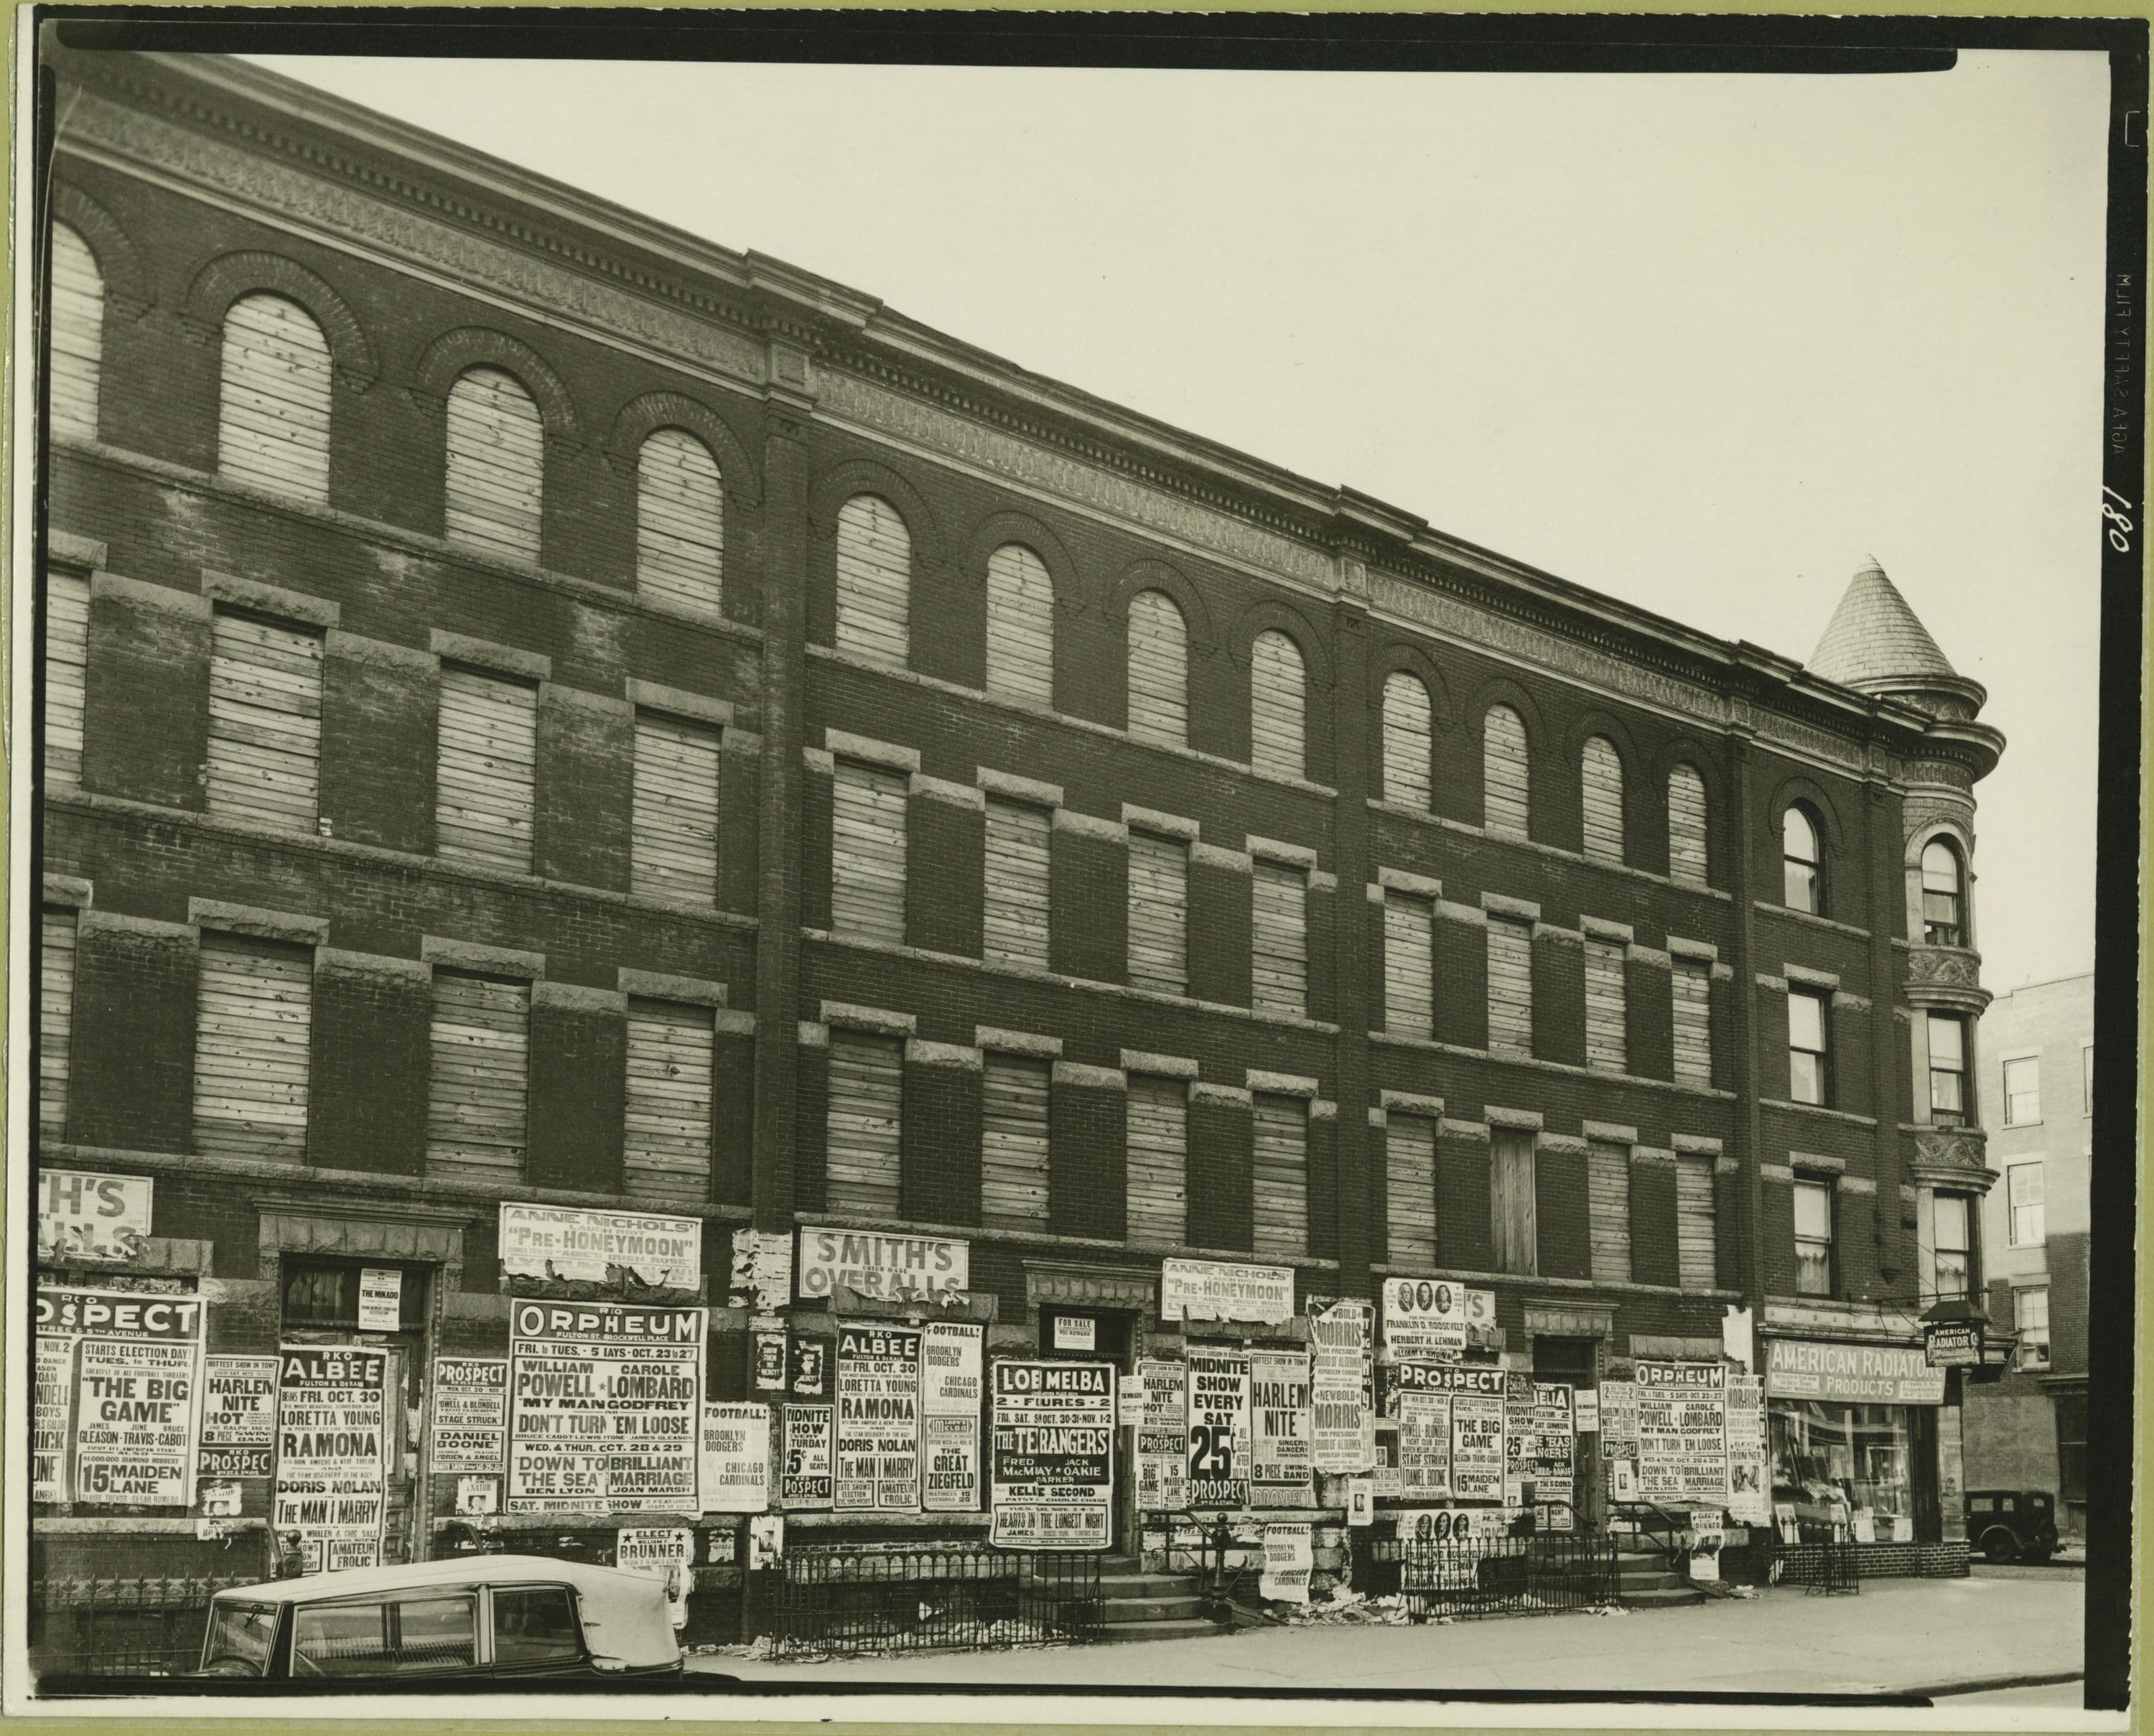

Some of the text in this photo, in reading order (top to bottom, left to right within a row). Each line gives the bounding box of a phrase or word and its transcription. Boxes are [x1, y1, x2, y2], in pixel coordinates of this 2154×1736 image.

[510, 1209, 579, 1224] ANNE
[817, 1233, 952, 1271] SMITH'S
[520, 1305, 696, 1342] ORPHEUM
[1058, 1318, 1091, 1328] FOR SALE
[1386, 1320, 1464, 1331] FRANKLIN ROOSEVELT
[841, 1335, 917, 1356] ALBEE
[1391, 1335, 1462, 1346] HERBERT LEHMAN
[1928, 1335, 1969, 1348] RADIATOR
[120, 1346, 167, 1359] ELECTION
[323, 1352, 353, 1361] RKO
[926, 1345, 961, 1357] BROOKLYN
[928, 1355, 959, 1367] DODGERS
[1772, 1343, 1856, 1374] AMERICAN
[284, 1357, 380, 1381] ALBEE
[522, 1361, 680, 1376] WILLIAM CAROLE
[854, 1362, 916, 1373] FRI. OCT. 30
[1189, 1358, 1249, 1375] MIDNITE
[944, 1376, 977, 1387] CHICAGO
[1046, 1371, 1105, 1393] MELBA
[1400, 1364, 1504, 1391] PROSPECT
[1638, 1365, 1723, 1388] ORPHEUM
[147, 1378, 188, 1401] BIG
[518, 1373, 694, 1400] POWELL LOMBARD
[839, 1378, 916, 1393] LORETTA YOUNG
[1144, 1378, 1183, 1391] HARLEM
[1196, 1376, 1241, 1392] SHOW
[1827, 1376, 1893, 1396] PRODUCTS
[300, 1391, 381, 1403] FRI. OCT. 30
[940, 1387, 978, 1399] CARDINALS
[1320, 1390, 1355, 1401] NEWBOLD
[559, 1399, 605, 1409] MAN
[1194, 1394, 1244, 1410] EVERY
[1640, 1401, 1672, 1410] WILLIAM
[206, 1412, 243, 1425] HOT
[281, 1411, 381, 1425] LORETTA YOUNG
[704, 1407, 767, 1419] FOOTBALL!
[1204, 1412, 1236, 1426] SAT.
[1315, 1403, 1361, 1429] MORRIS
[1638, 1411, 1722, 1427] POWELL LOMBARD
[1481, 1420, 1500, 1434] BIG
[205, 1431, 215, 1441] 8
[704, 1429, 746, 1441] BROOKLYN
[565, 1444, 596, 1452] THUR.
[706, 1440, 743, 1452] DODGERS
[839, 1439, 916, 1452] DORIS NOLAN
[1141, 1436, 1184, 1452] PROSPECT
[1661, 1438, 1722, 1450] TURN LOOSE
[610, 1457, 693, 1470] BRILLIANT
[725, 1462, 763, 1473] CHICAGO
[883, 1457, 915, 1479] MARRY
[934, 1455, 968, 1472] GREAT
[1642, 1465, 1681, 1475] DOWN TO
[1064, 1467, 1101, 1476] OAKIE
[1143, 1468, 1156, 1480] BIG
[1254, 1464, 1262, 1478] 8
[1406, 1469, 1446, 1486] DANIEL BOONE
[1684, 1467, 1725, 1476] BRILLIANT
[83, 1465, 182, 1493] 15 MAIDEN
[518, 1473, 556, 1487] THE
[610, 1473, 693, 1486] MARRIAGE
[719, 1475, 765, 1486] CARDINALS
[928, 1473, 974, 1490] ZIEGFELD
[1164, 1477, 1184, 1486] MAIDEN
[1457, 1474, 1499, 1493] 15 MAIDEN
[1642, 1477, 1678, 1485] THE SEA
[1685, 1477, 1725, 1486] MARRIAGE
[110, 1480, 159, 1494] LANE
[277, 1480, 381, 1494] DORIS NOLAN
[881, 1483, 915, 1493] AMATEUR
[1050, 1488, 1096, 1497] SECOND
[1139, 1480, 1159, 1492] GAME
[1192, 1479, 1249, 1504] PROSPECT
[510, 1501, 603, 1511] SAT. MIDNITE
[885, 1494, 912, 1505] FROLIC
[300, 1500, 378, 1524] MAN MARRY
[1055, 1513, 1104, 1529] LONGEST NIGHT
[332, 1543, 376, 1555] AMATEUR
[620, 1544, 684, 1559] BRUNNER
[337, 1556, 371, 1568] FROLIC
[1269, 1552, 1295, 1562] DODGERS
